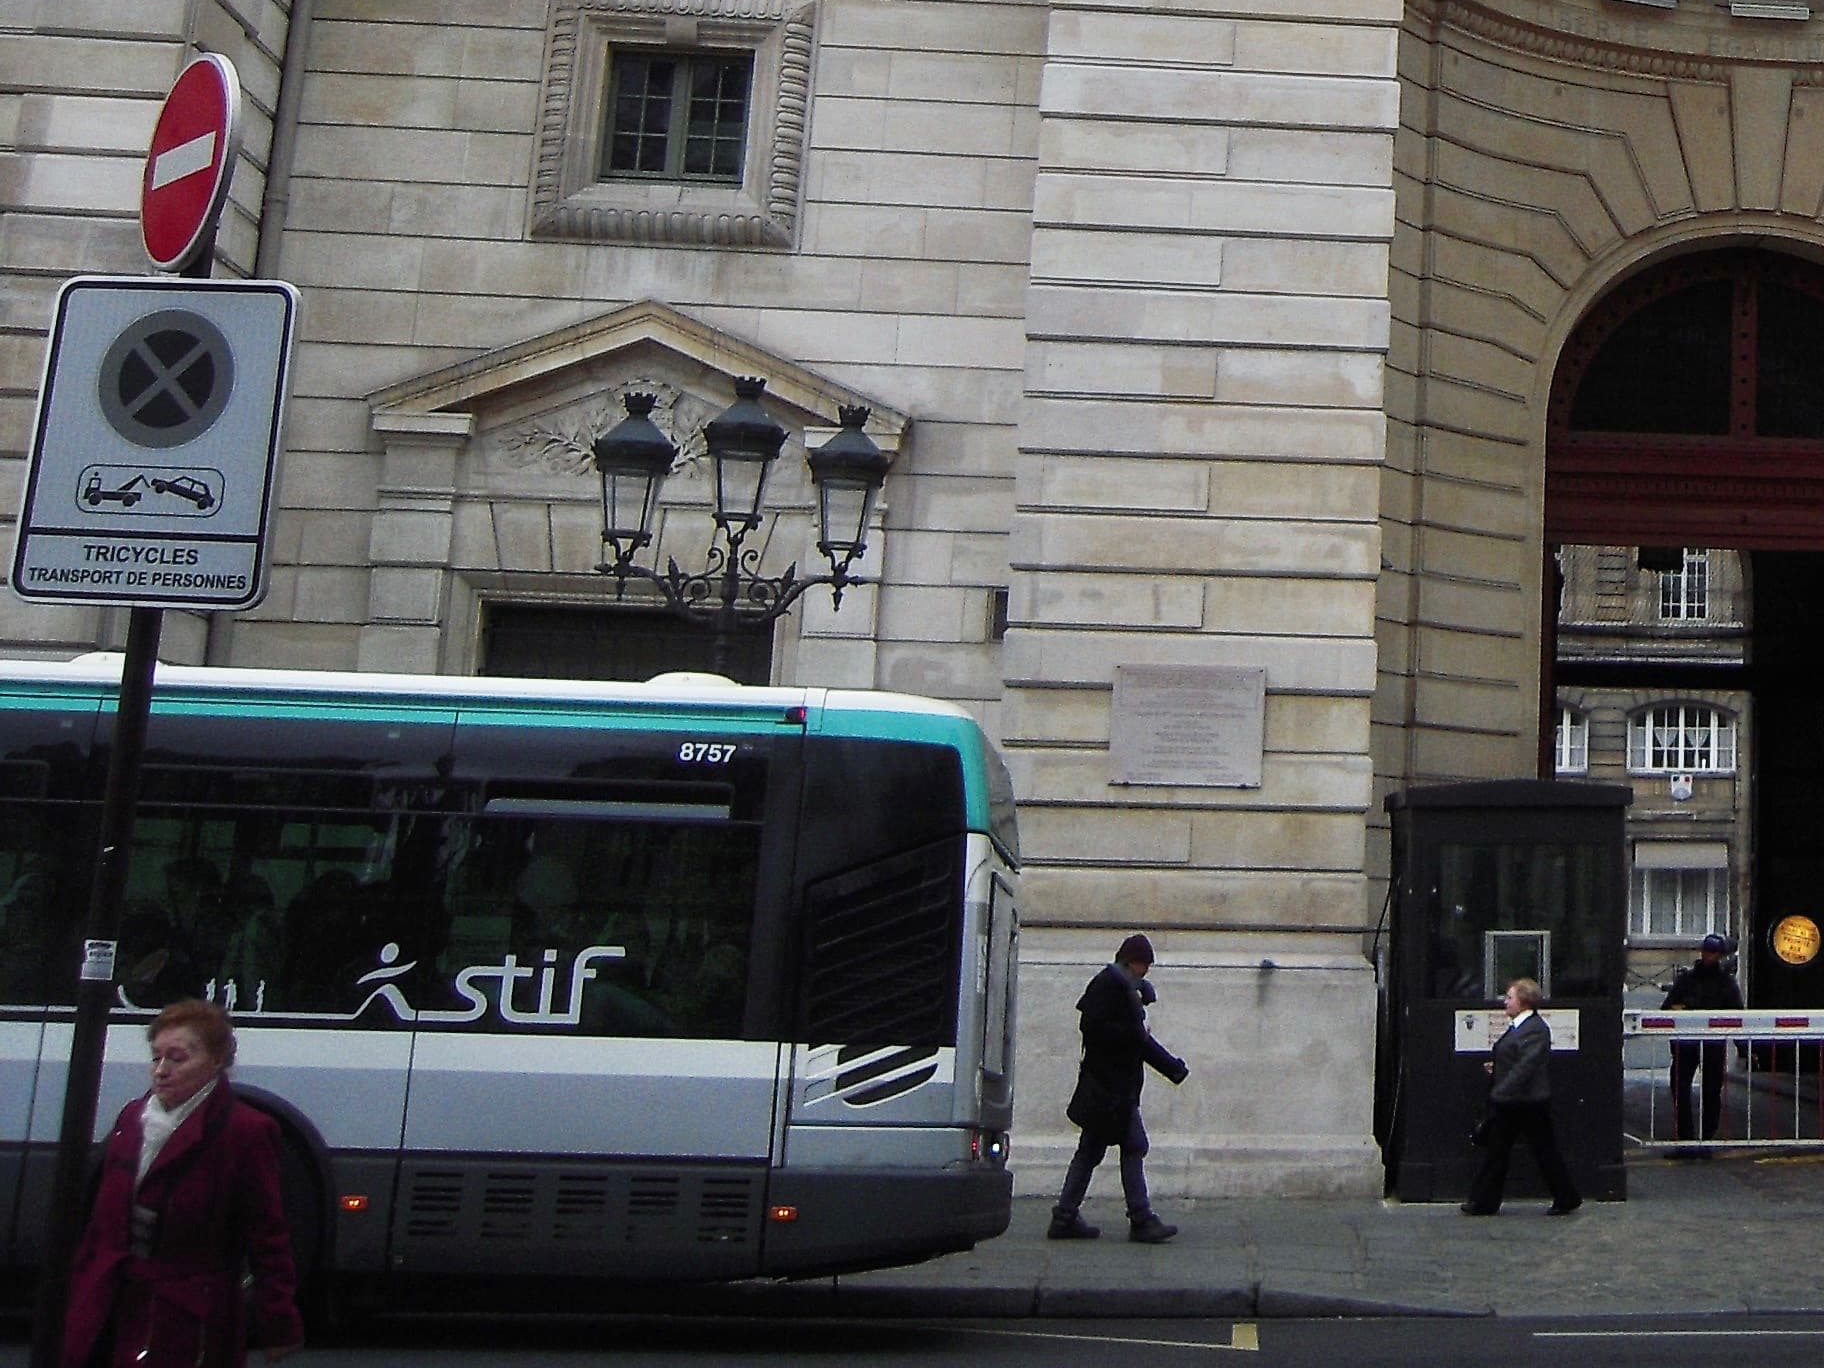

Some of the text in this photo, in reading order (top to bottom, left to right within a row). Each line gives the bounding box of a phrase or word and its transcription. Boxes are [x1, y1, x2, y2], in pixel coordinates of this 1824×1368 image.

[83, 544, 199, 565] TRICYCLES
[28, 567, 246, 590] TRANSPORT DE PERSONNES
[680, 742, 736, 762] 8757
[430, 945, 626, 1024] stif
